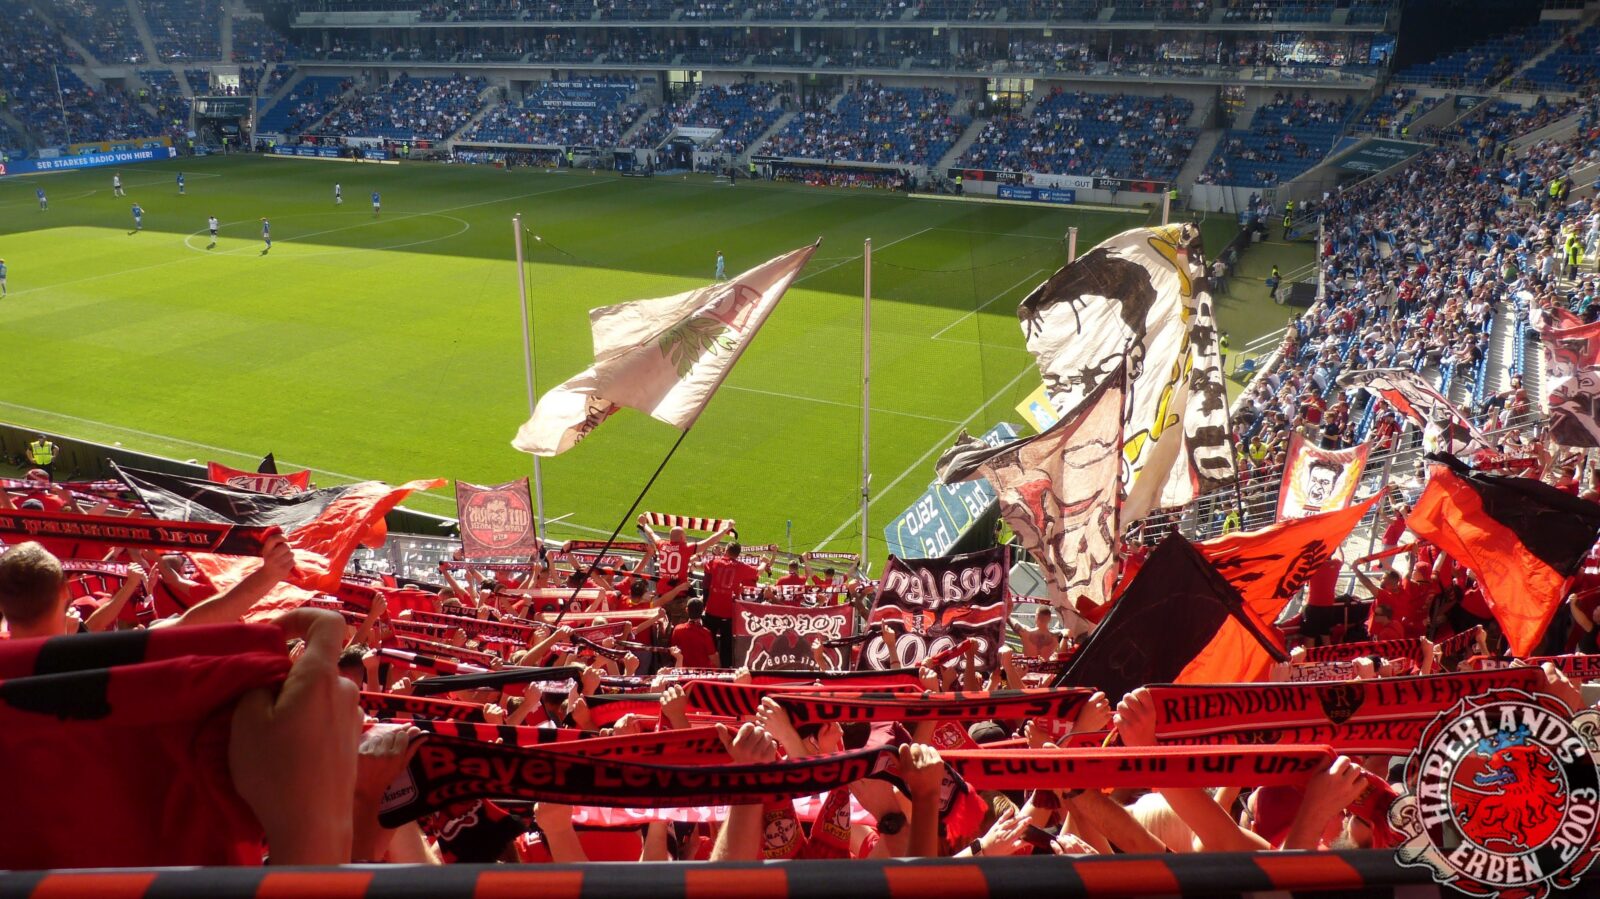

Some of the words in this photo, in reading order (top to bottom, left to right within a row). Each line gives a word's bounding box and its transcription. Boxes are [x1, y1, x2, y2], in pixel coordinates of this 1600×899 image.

[55, 157, 89, 168] STARKES
[90, 153, 115, 164] RADIO
[116, 152, 133, 161] VON
[134, 151, 153, 160] HIER!
[659, 551, 682, 574] 20
[1163, 686, 1313, 725] RHEINDORF
[419, 746, 572, 786] Bayer
